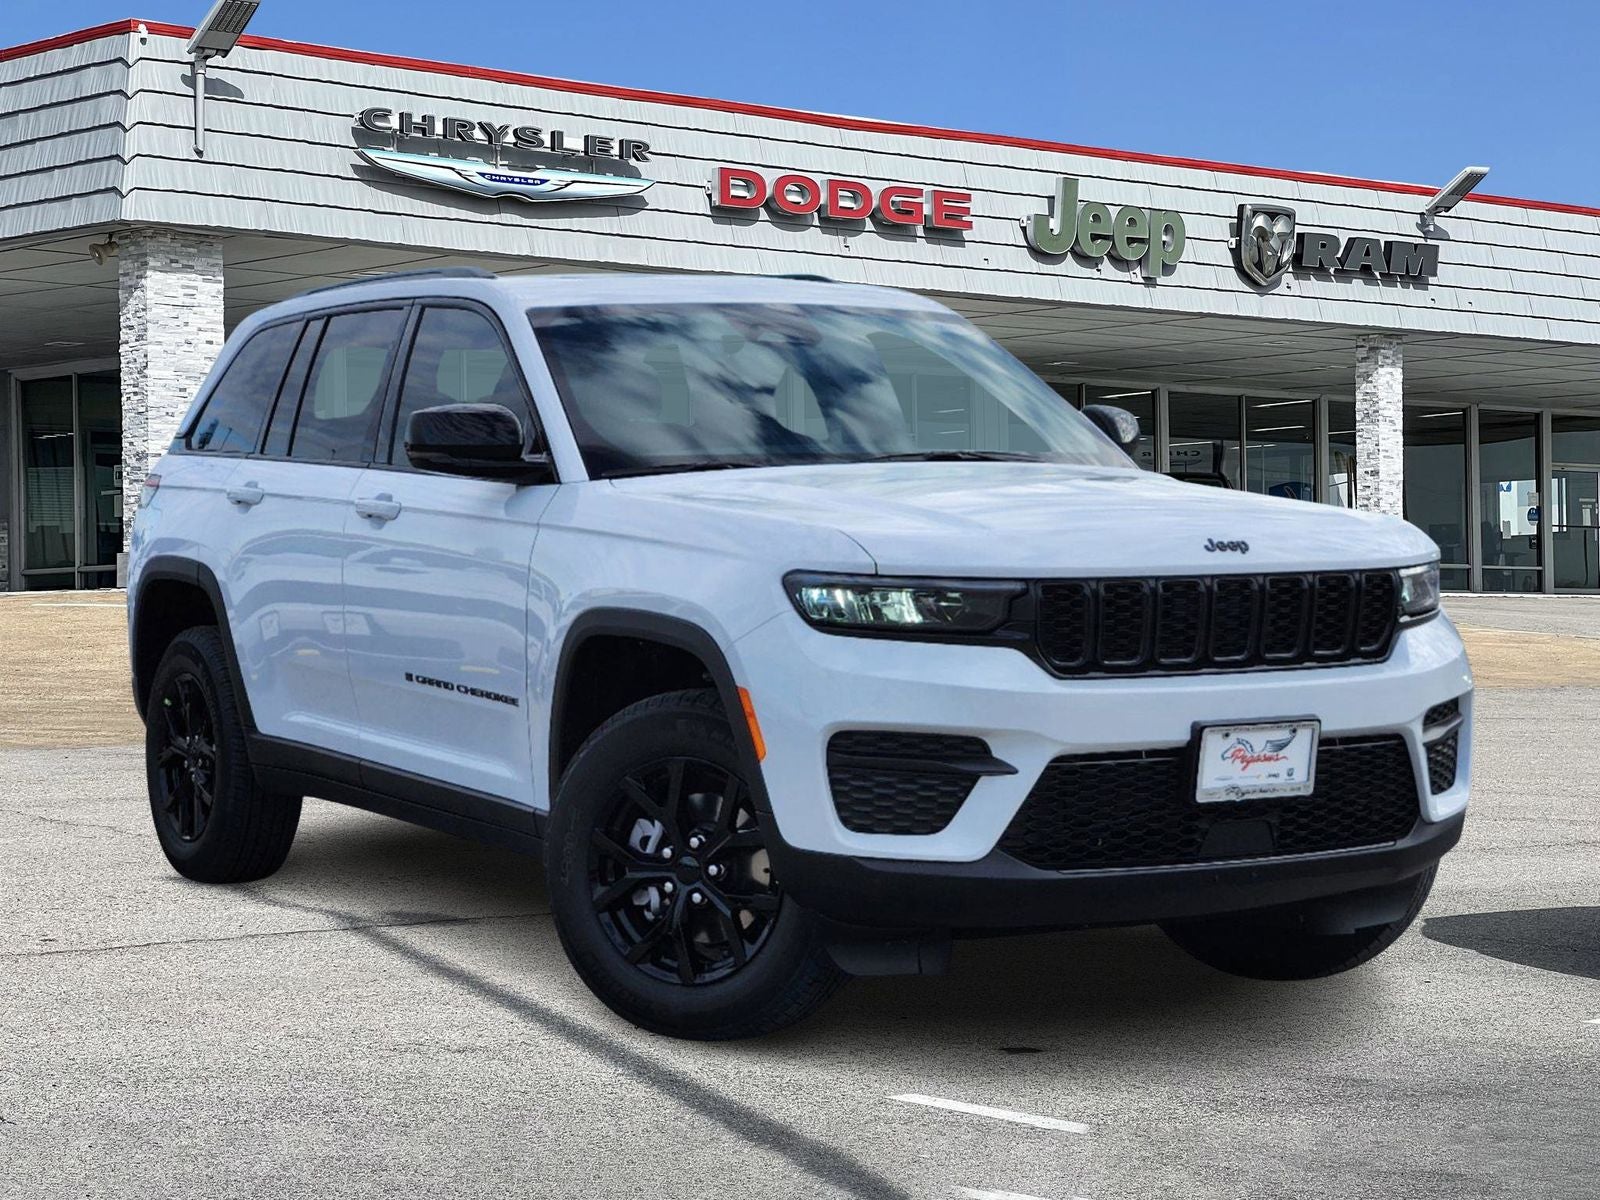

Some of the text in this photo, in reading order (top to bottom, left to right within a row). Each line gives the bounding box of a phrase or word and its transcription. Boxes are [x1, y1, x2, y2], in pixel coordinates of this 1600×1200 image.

[357, 106, 651, 162] CHRYSLER
[484, 174, 541, 185] CHRYSLER
[711, 166, 974, 231] DODGE
[1024, 177, 1187, 278] Jeep
[1299, 232, 1440, 277] RAM
[1203, 537, 1250, 555] Jeep
[415, 674, 519, 707] GRAND CHEROKEE
